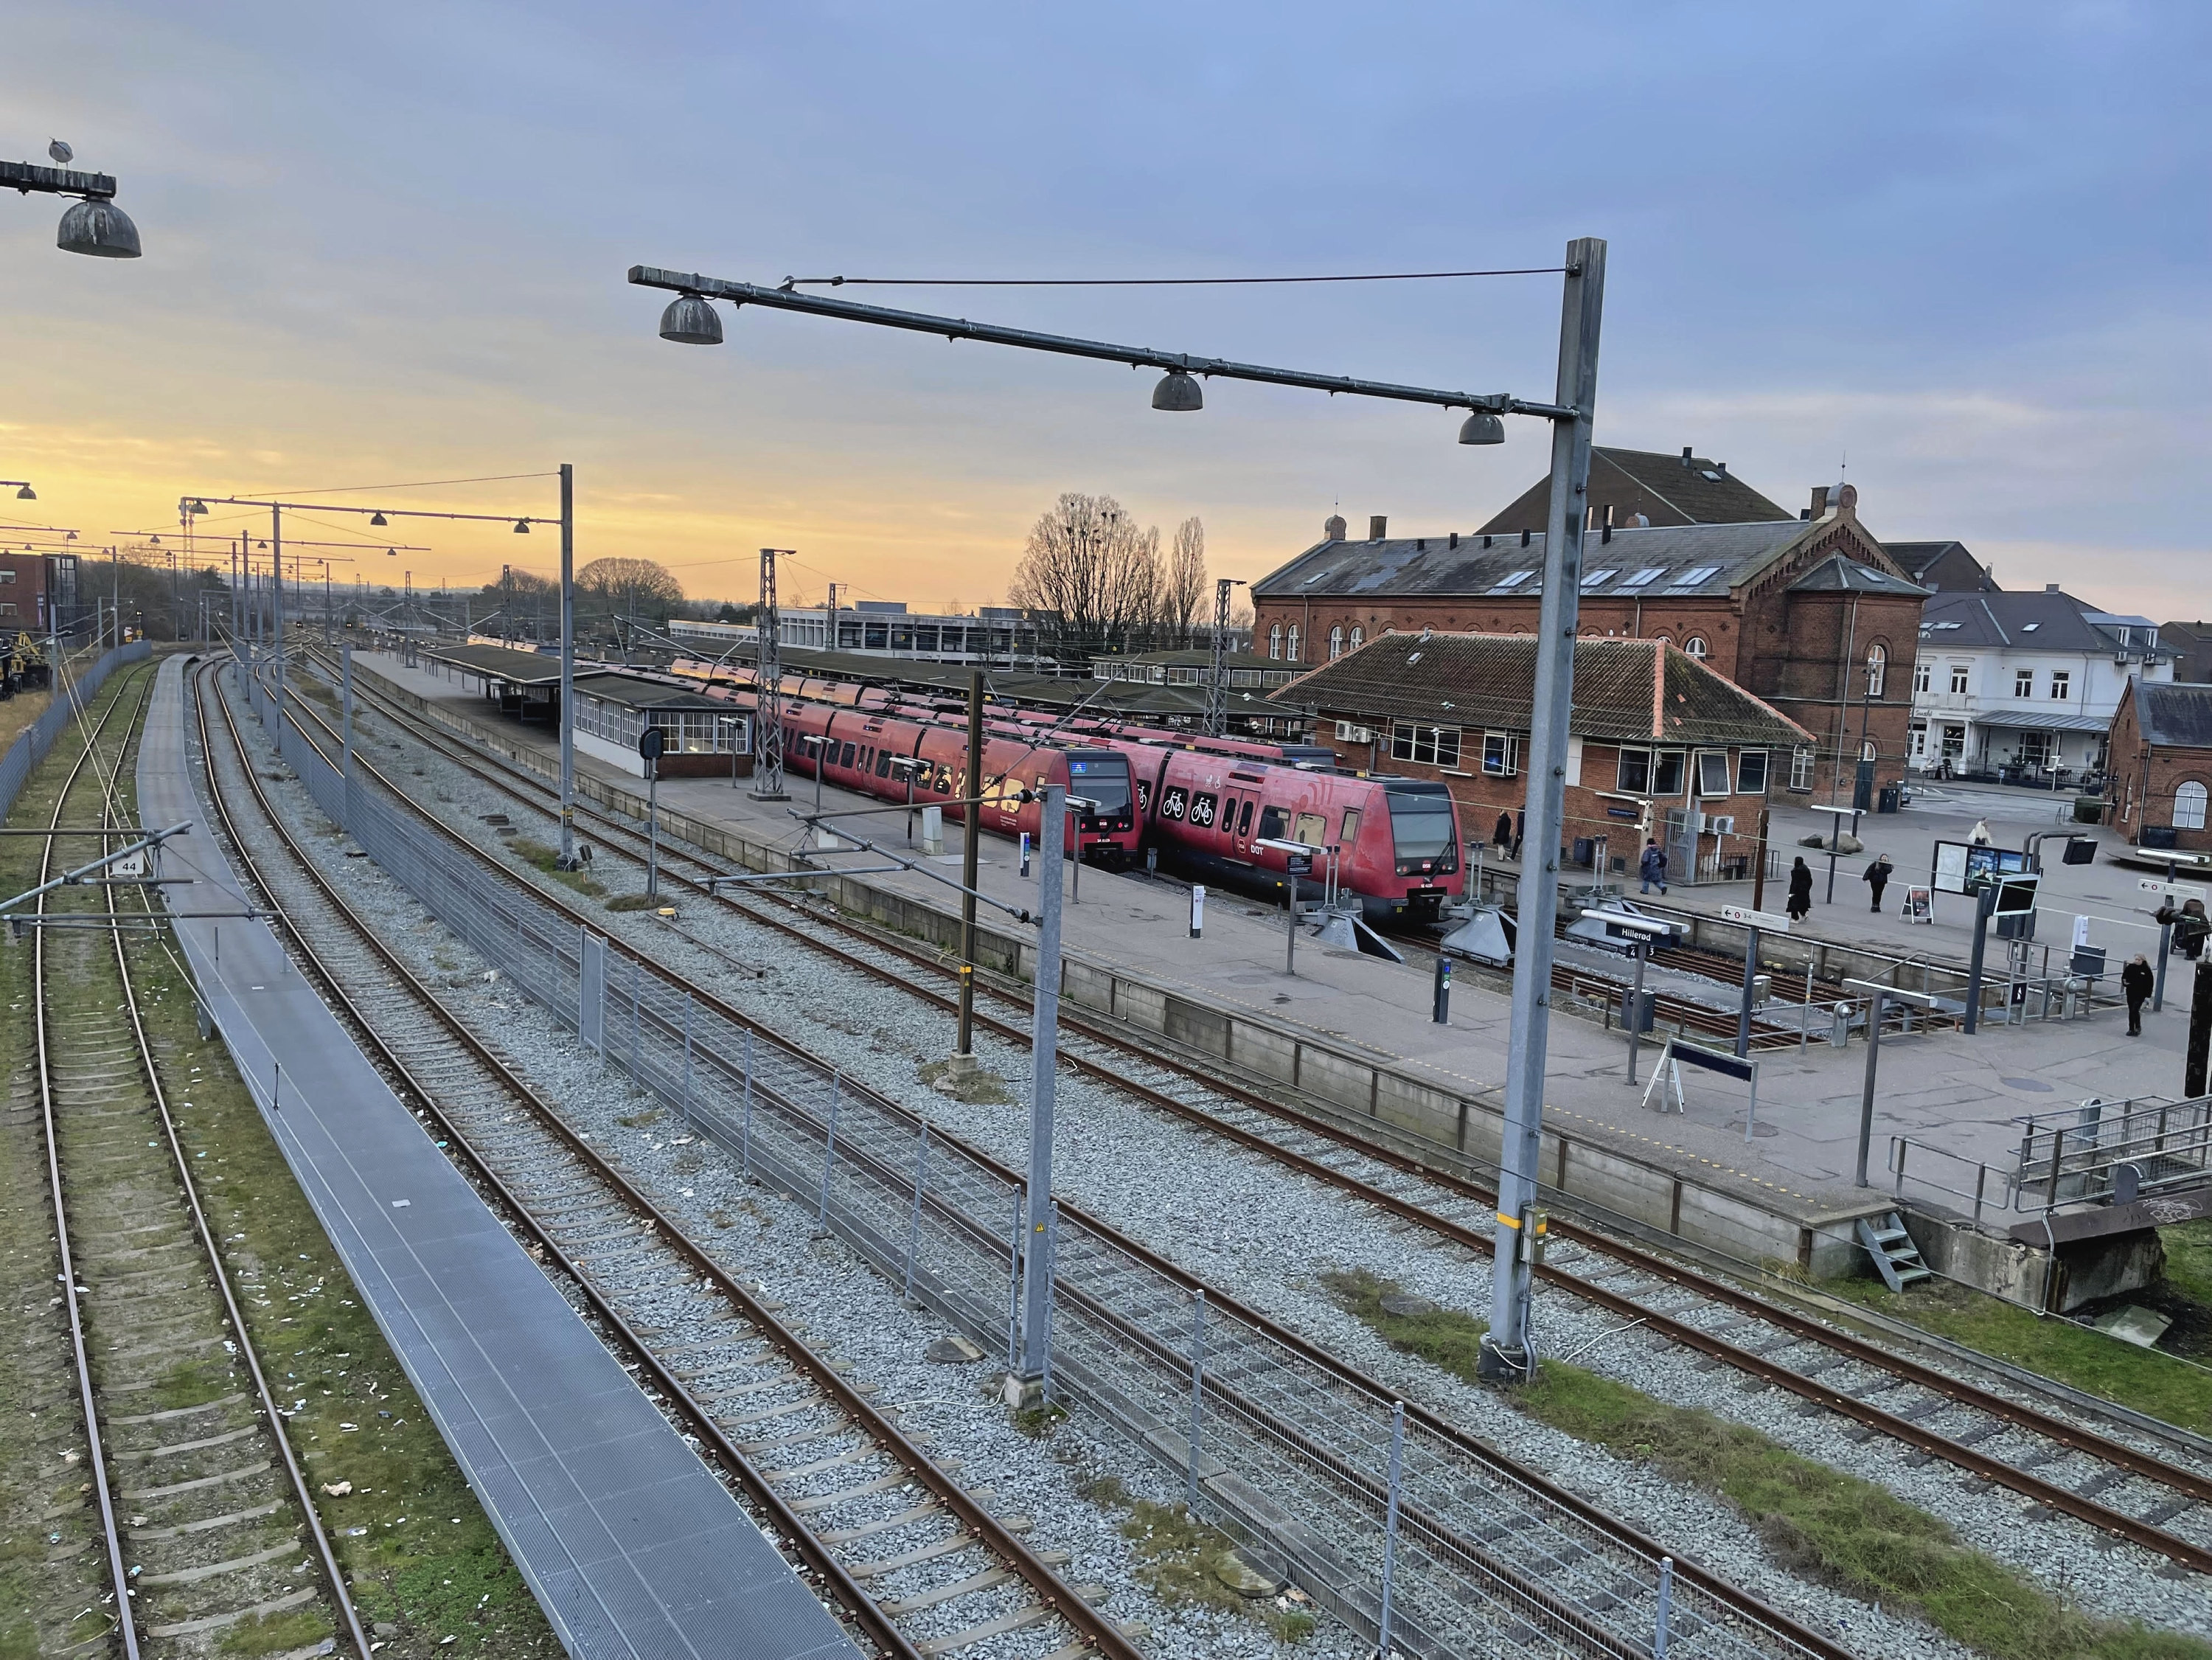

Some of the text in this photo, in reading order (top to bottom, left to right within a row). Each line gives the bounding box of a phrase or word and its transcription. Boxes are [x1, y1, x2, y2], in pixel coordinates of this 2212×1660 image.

[1251, 844, 1264, 855] DOT
[122, 862, 136, 871] 44
[1621, 928, 1652, 942] Hillerød
[1630, 948, 1635, 956] 4
[1649, 948, 1654, 956] 3
